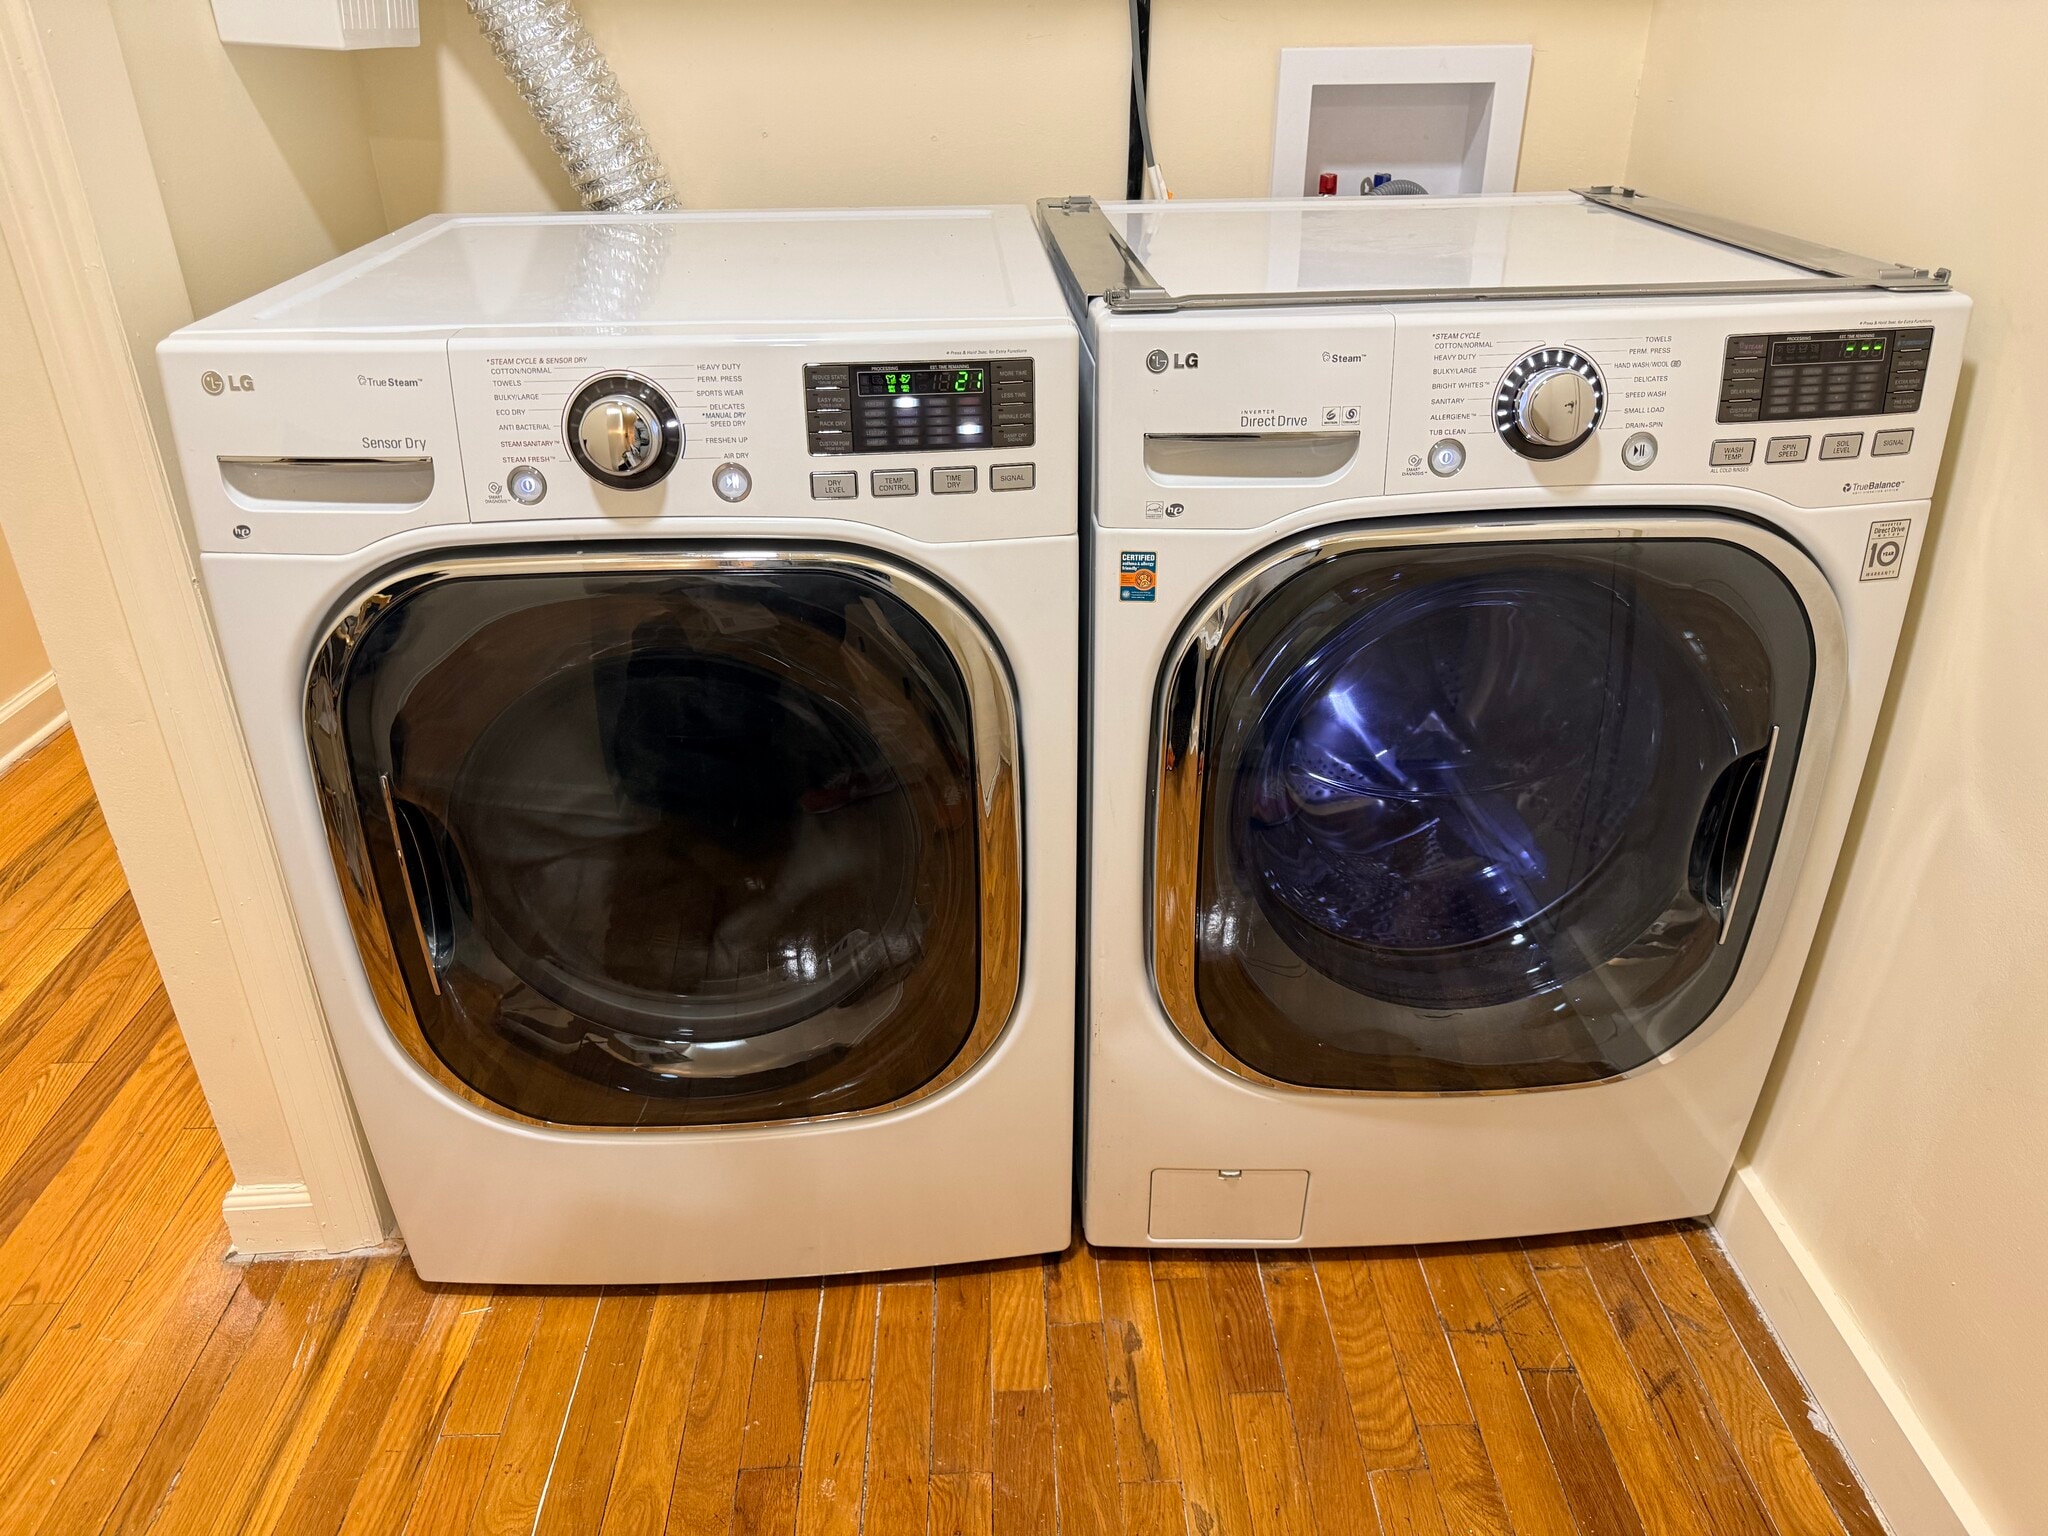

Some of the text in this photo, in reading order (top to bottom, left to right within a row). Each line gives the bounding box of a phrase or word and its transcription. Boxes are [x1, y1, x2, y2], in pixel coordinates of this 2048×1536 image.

[1174, 353, 1199, 369] LG
[491, 367, 552, 375] COTTON/NORMAL
[228, 375, 255, 392] LG
[955, 372, 982, 391] 21
[1240, 415, 1308, 427] Direct Drive
[516, 423, 551, 431] BACTERIAL
[362, 437, 426, 451] Sensor Dry
[1836, 440, 1850, 448] SOIL
[1000, 474, 1024, 482] SIGNAL
[879, 484, 911, 492] CONTROL
[947, 481, 960, 489] DRY
[825, 486, 845, 494] LEVEL
[1869, 541, 1900, 568] 10
